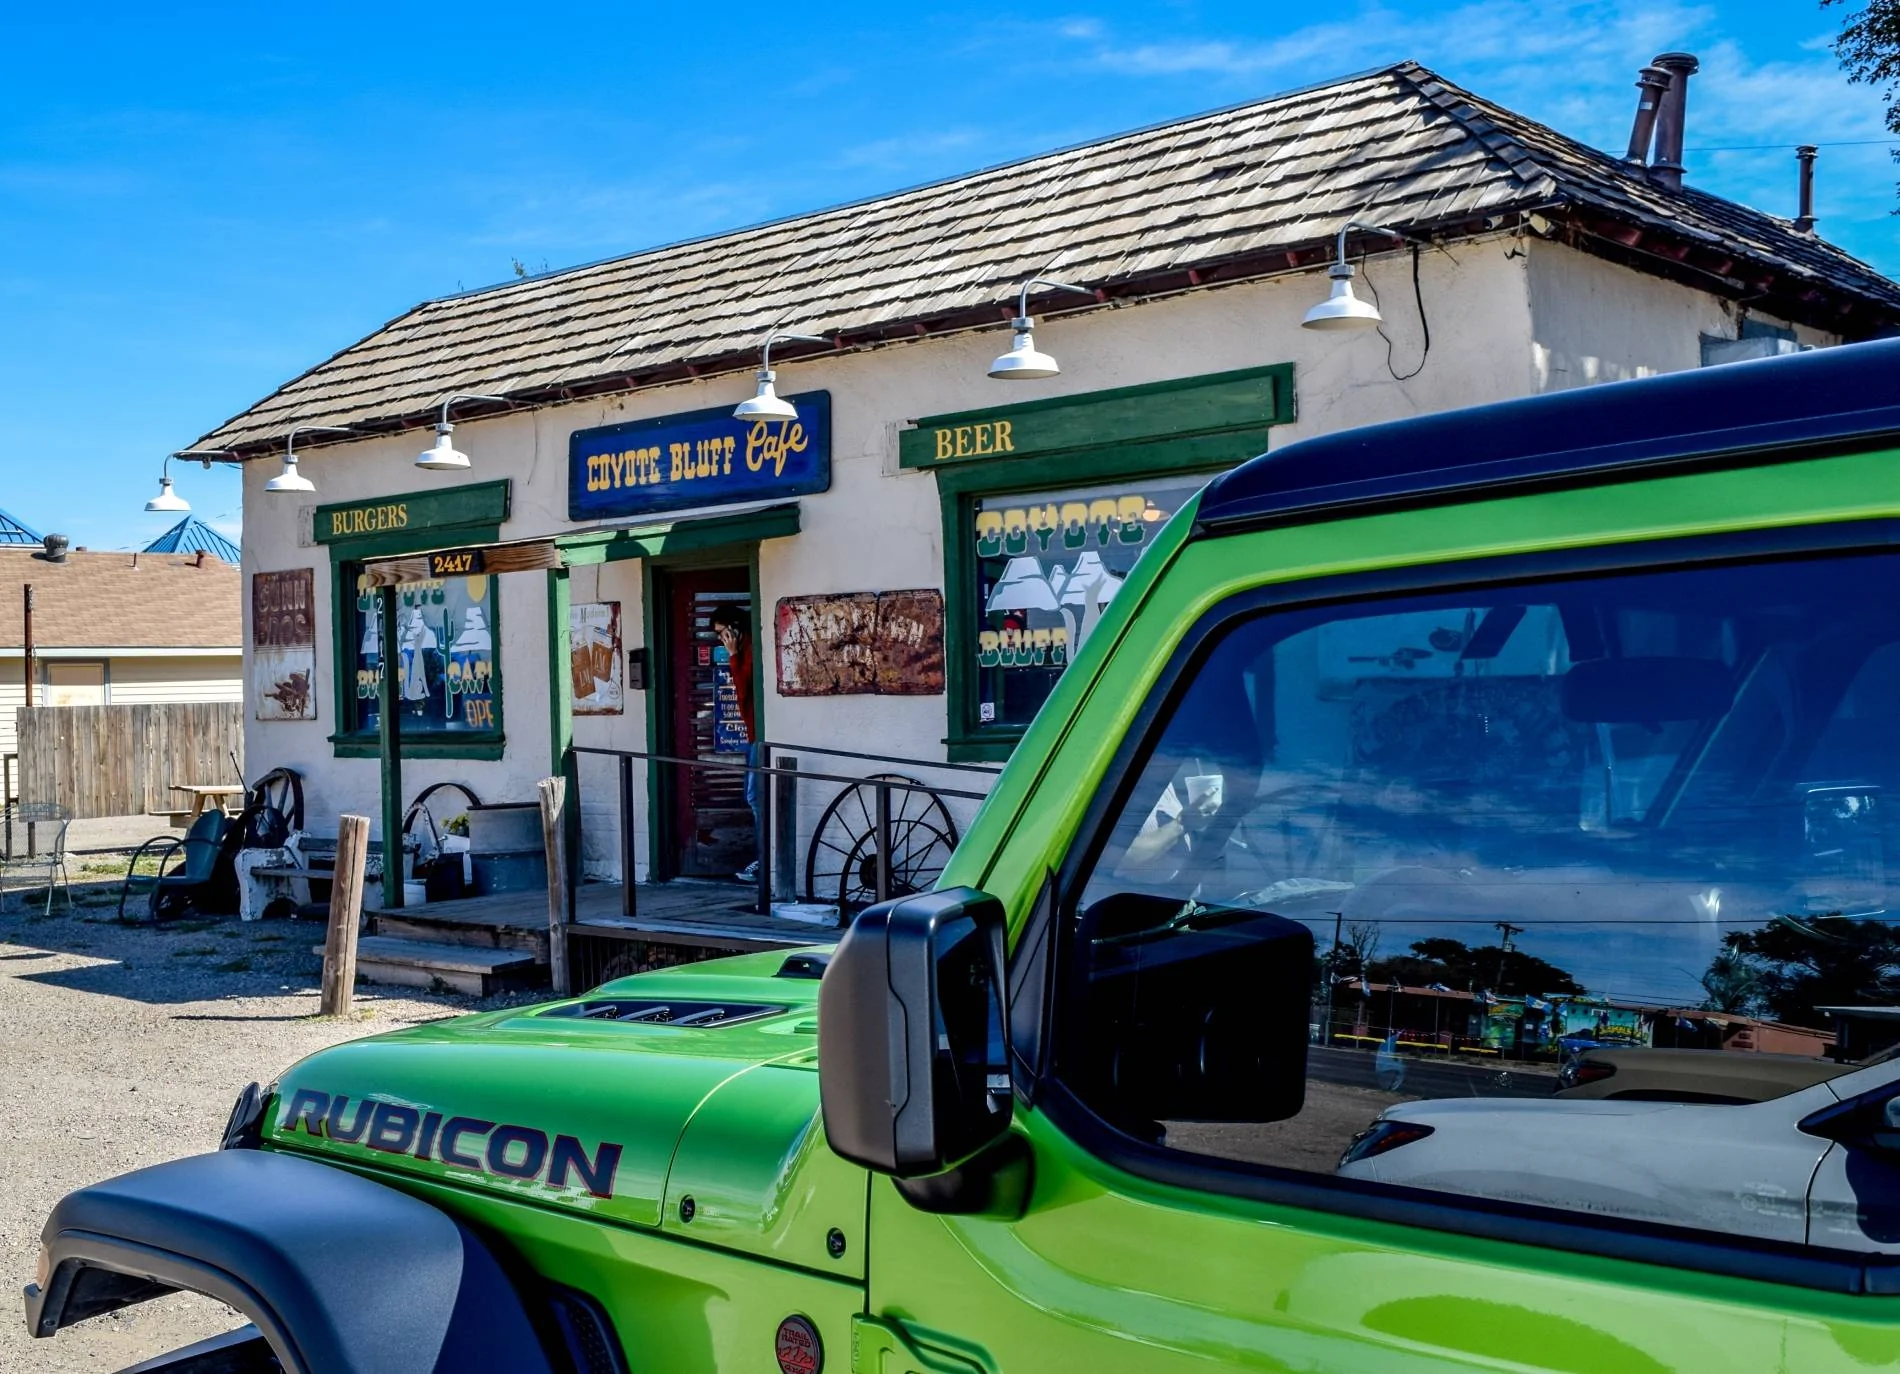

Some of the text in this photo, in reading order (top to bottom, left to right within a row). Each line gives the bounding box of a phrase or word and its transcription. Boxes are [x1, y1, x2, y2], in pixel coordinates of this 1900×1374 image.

[586, 420, 809, 492] COYOTE BLUFF Cafe
[934, 420, 1015, 460] BEER
[332, 503, 408, 537] BURGERS
[976, 496, 1146, 558] COYOTE
[434, 554, 473, 573] 2417
[978, 627, 1069, 668] BLUFF
[283, 1088, 624, 1200] RUBICON
[783, 1327, 809, 1341] TRAIL
